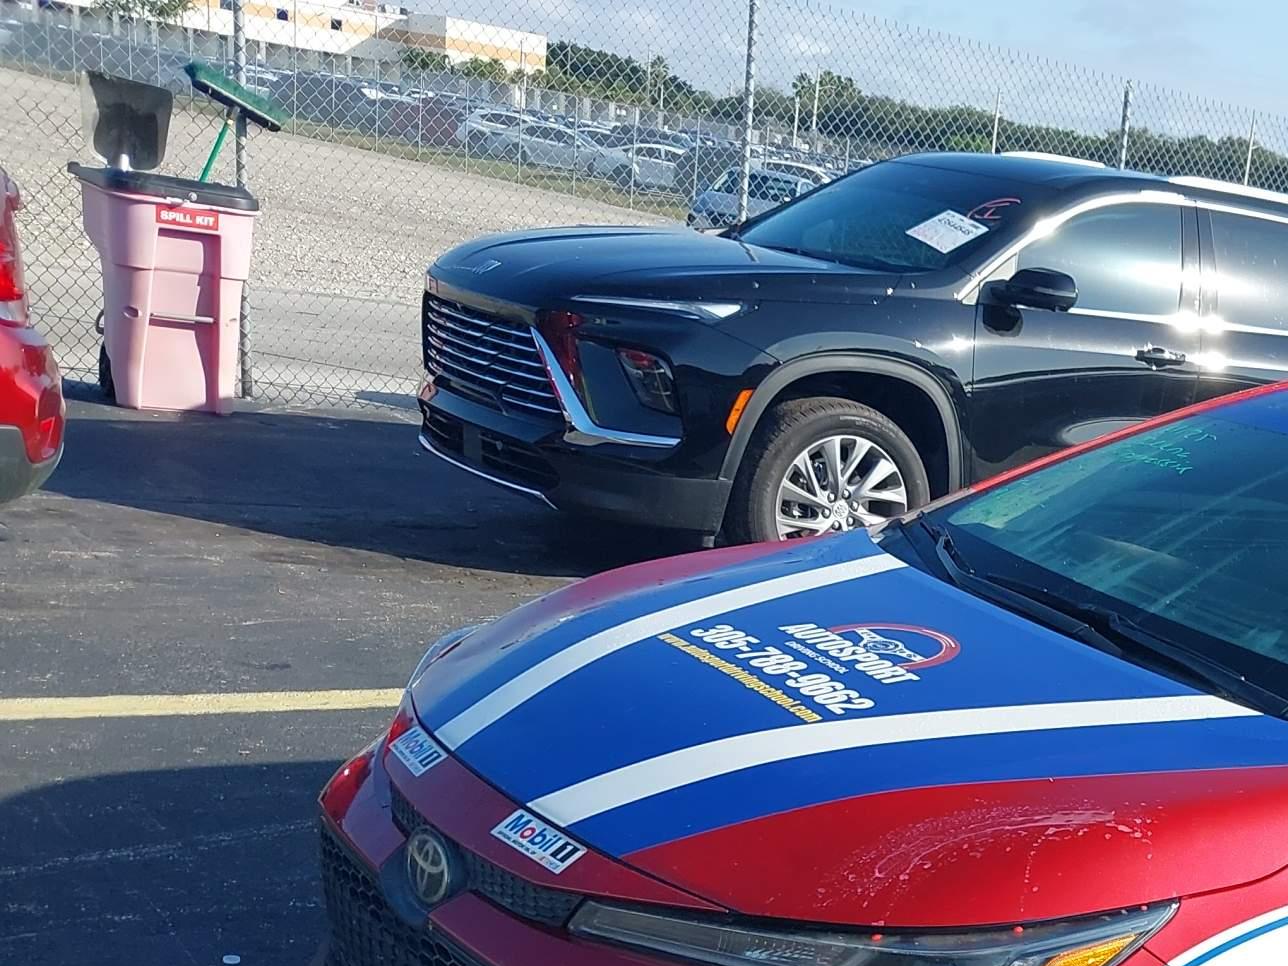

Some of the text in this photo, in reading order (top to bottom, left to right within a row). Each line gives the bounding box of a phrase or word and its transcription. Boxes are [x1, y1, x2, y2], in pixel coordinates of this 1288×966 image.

[160, 210, 215, 226] SPILL KIT
[690, 624, 875, 714] 305-788-9662
[777, 623, 920, 684] AUTOSPORT
[399, 729, 433, 760] Mobil
[504, 813, 562, 853] Mobil
[552, 842, 579, 862] 1
